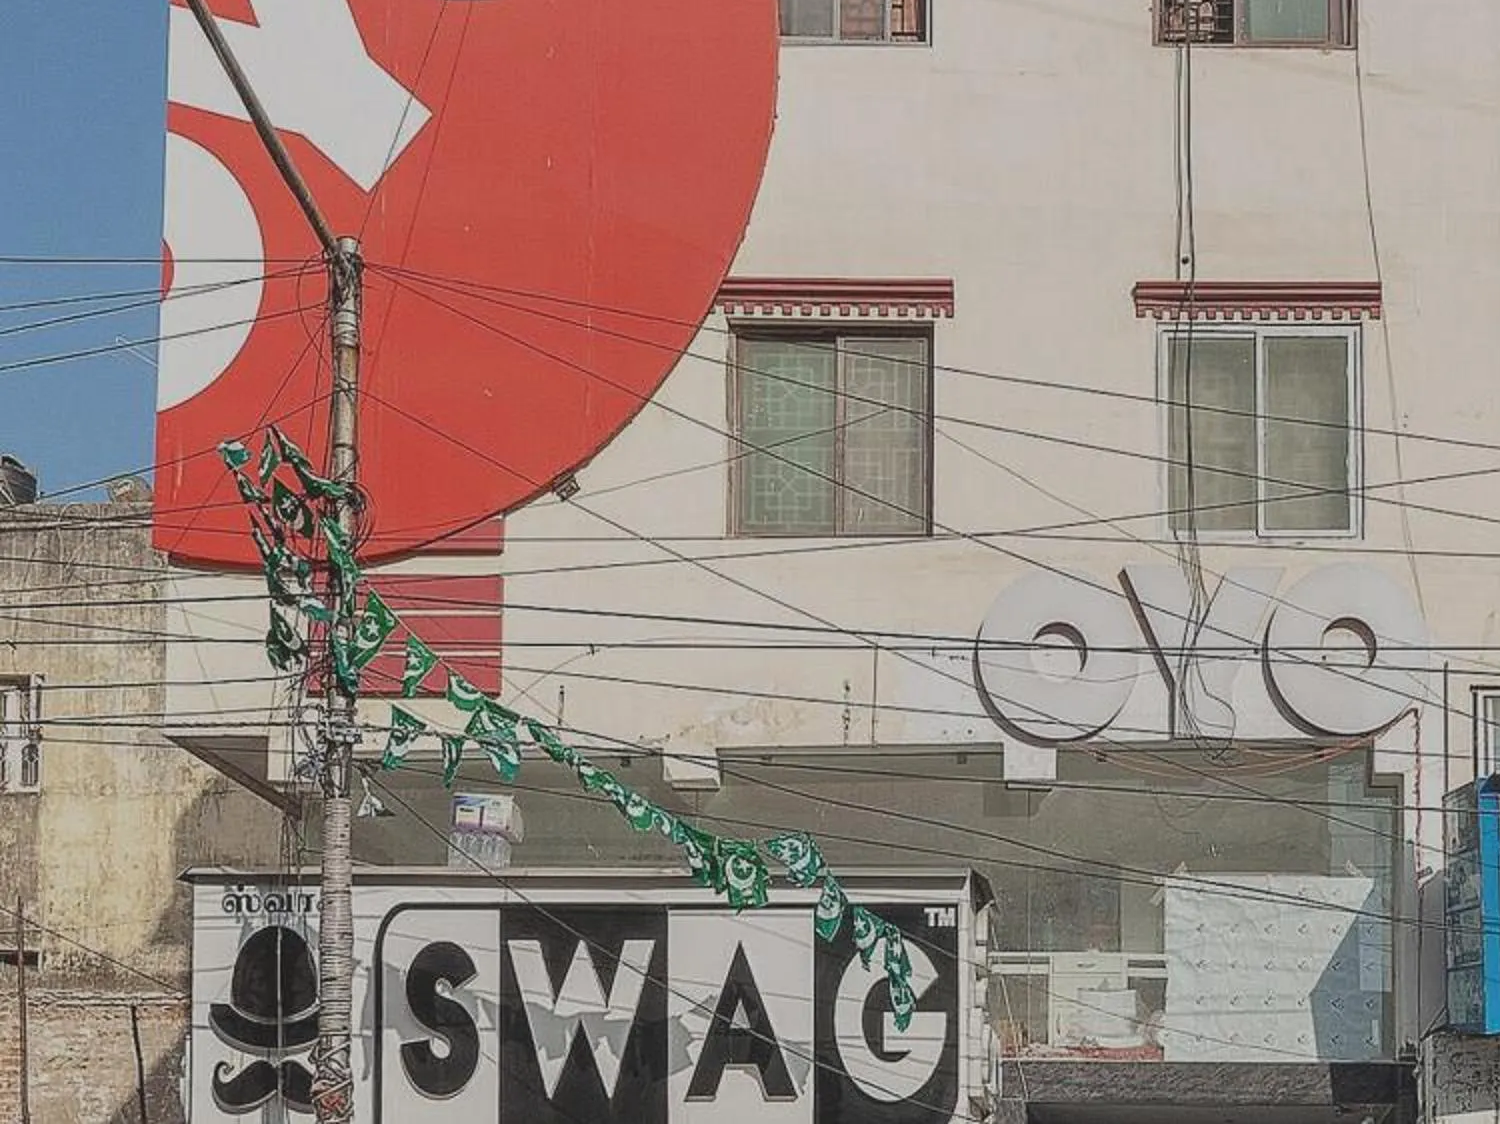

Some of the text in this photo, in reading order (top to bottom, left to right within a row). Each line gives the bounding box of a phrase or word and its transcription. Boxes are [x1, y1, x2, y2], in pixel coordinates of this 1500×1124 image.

[972, 561, 1430, 747] OYO
[925, 907, 957, 928] TM
[399, 938, 948, 1104] SWAG
